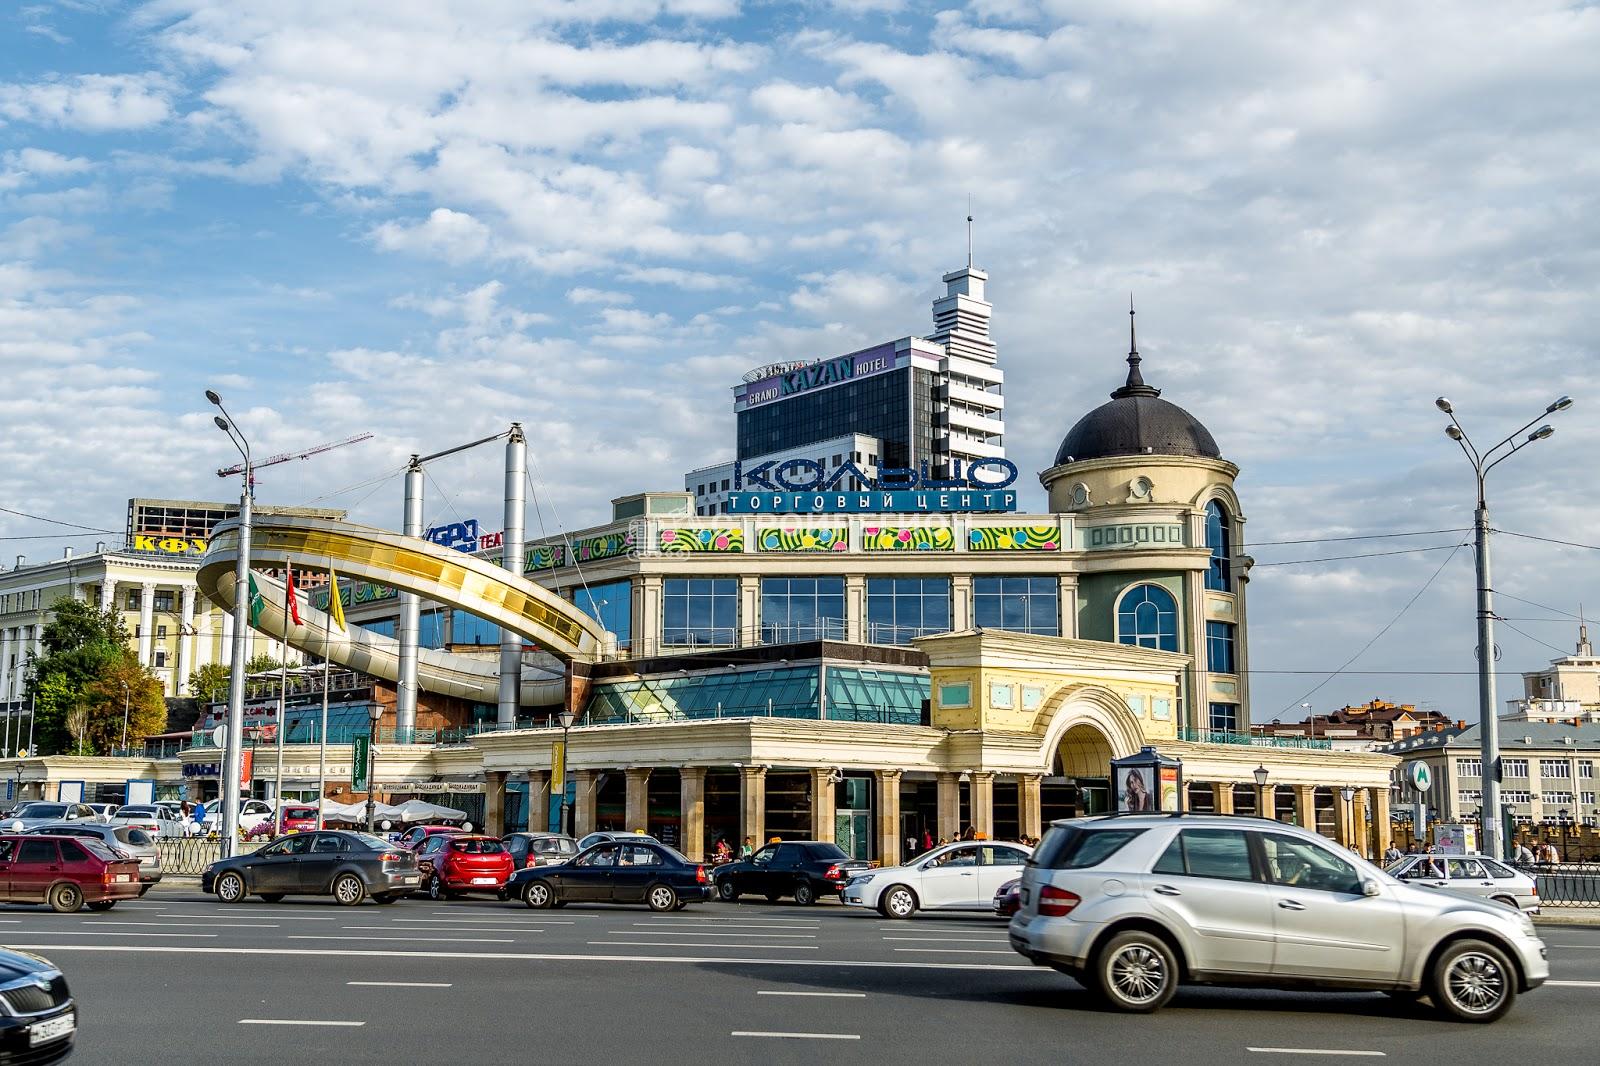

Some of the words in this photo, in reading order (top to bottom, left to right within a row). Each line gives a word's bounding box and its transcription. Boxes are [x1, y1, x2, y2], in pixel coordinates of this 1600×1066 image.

[749, 388, 778, 405] GRAND
[780, 356, 856, 396] KAZAN
[856, 357, 888, 375] HOTEL
[734, 457, 1018, 491] КОЛЬЦО
[730, 493, 893, 509] ТОРГОВЫЙ
[917, 493, 1014, 509] ЦЕНТР
[134, 536, 208, 555] КФУ
[1417, 768, 1428, 783] М
